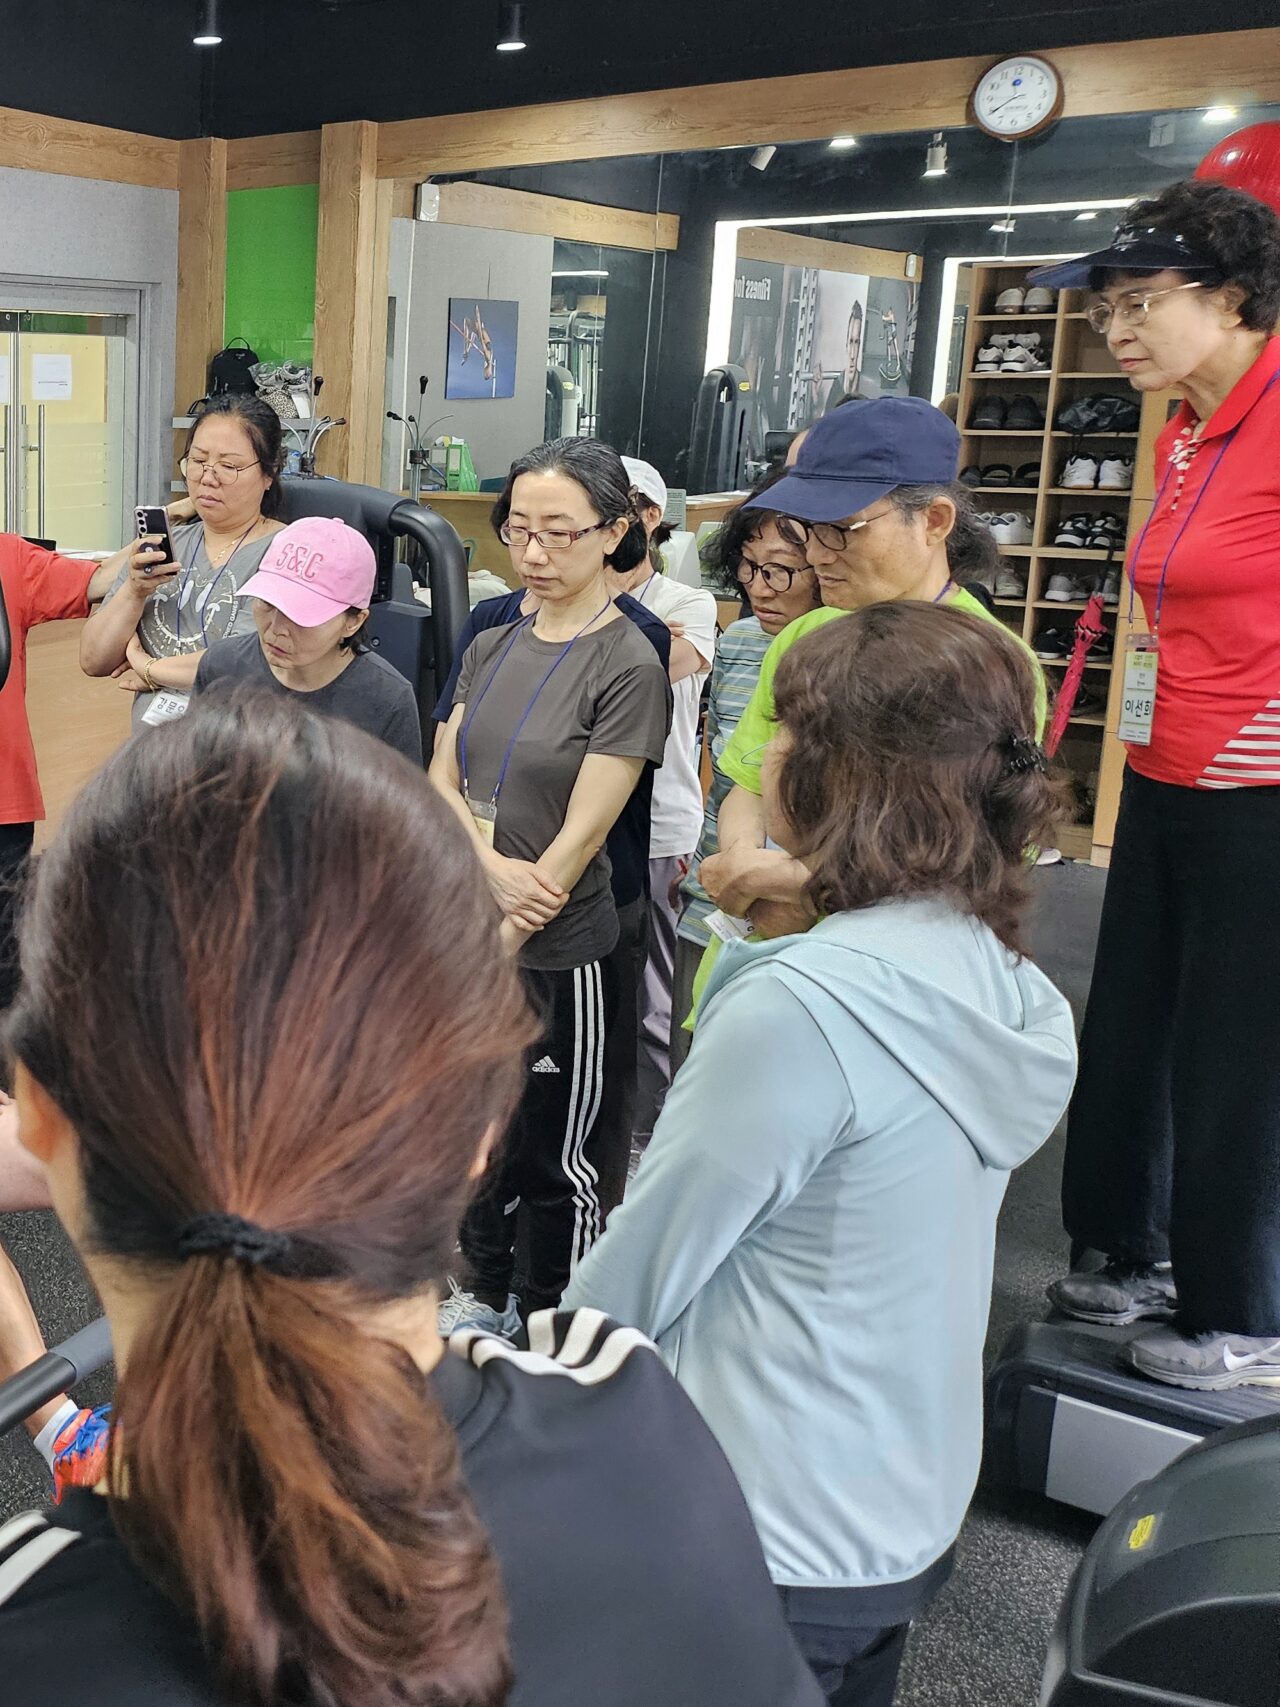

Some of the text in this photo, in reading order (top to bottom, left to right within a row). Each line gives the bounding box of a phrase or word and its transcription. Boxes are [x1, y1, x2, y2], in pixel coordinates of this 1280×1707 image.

[1001, 71, 1008, 80] 11
[1015, 66, 1024, 75] 12
[276, 542, 324, 580] S&C
[1125, 699, 1152, 718] 이선희
